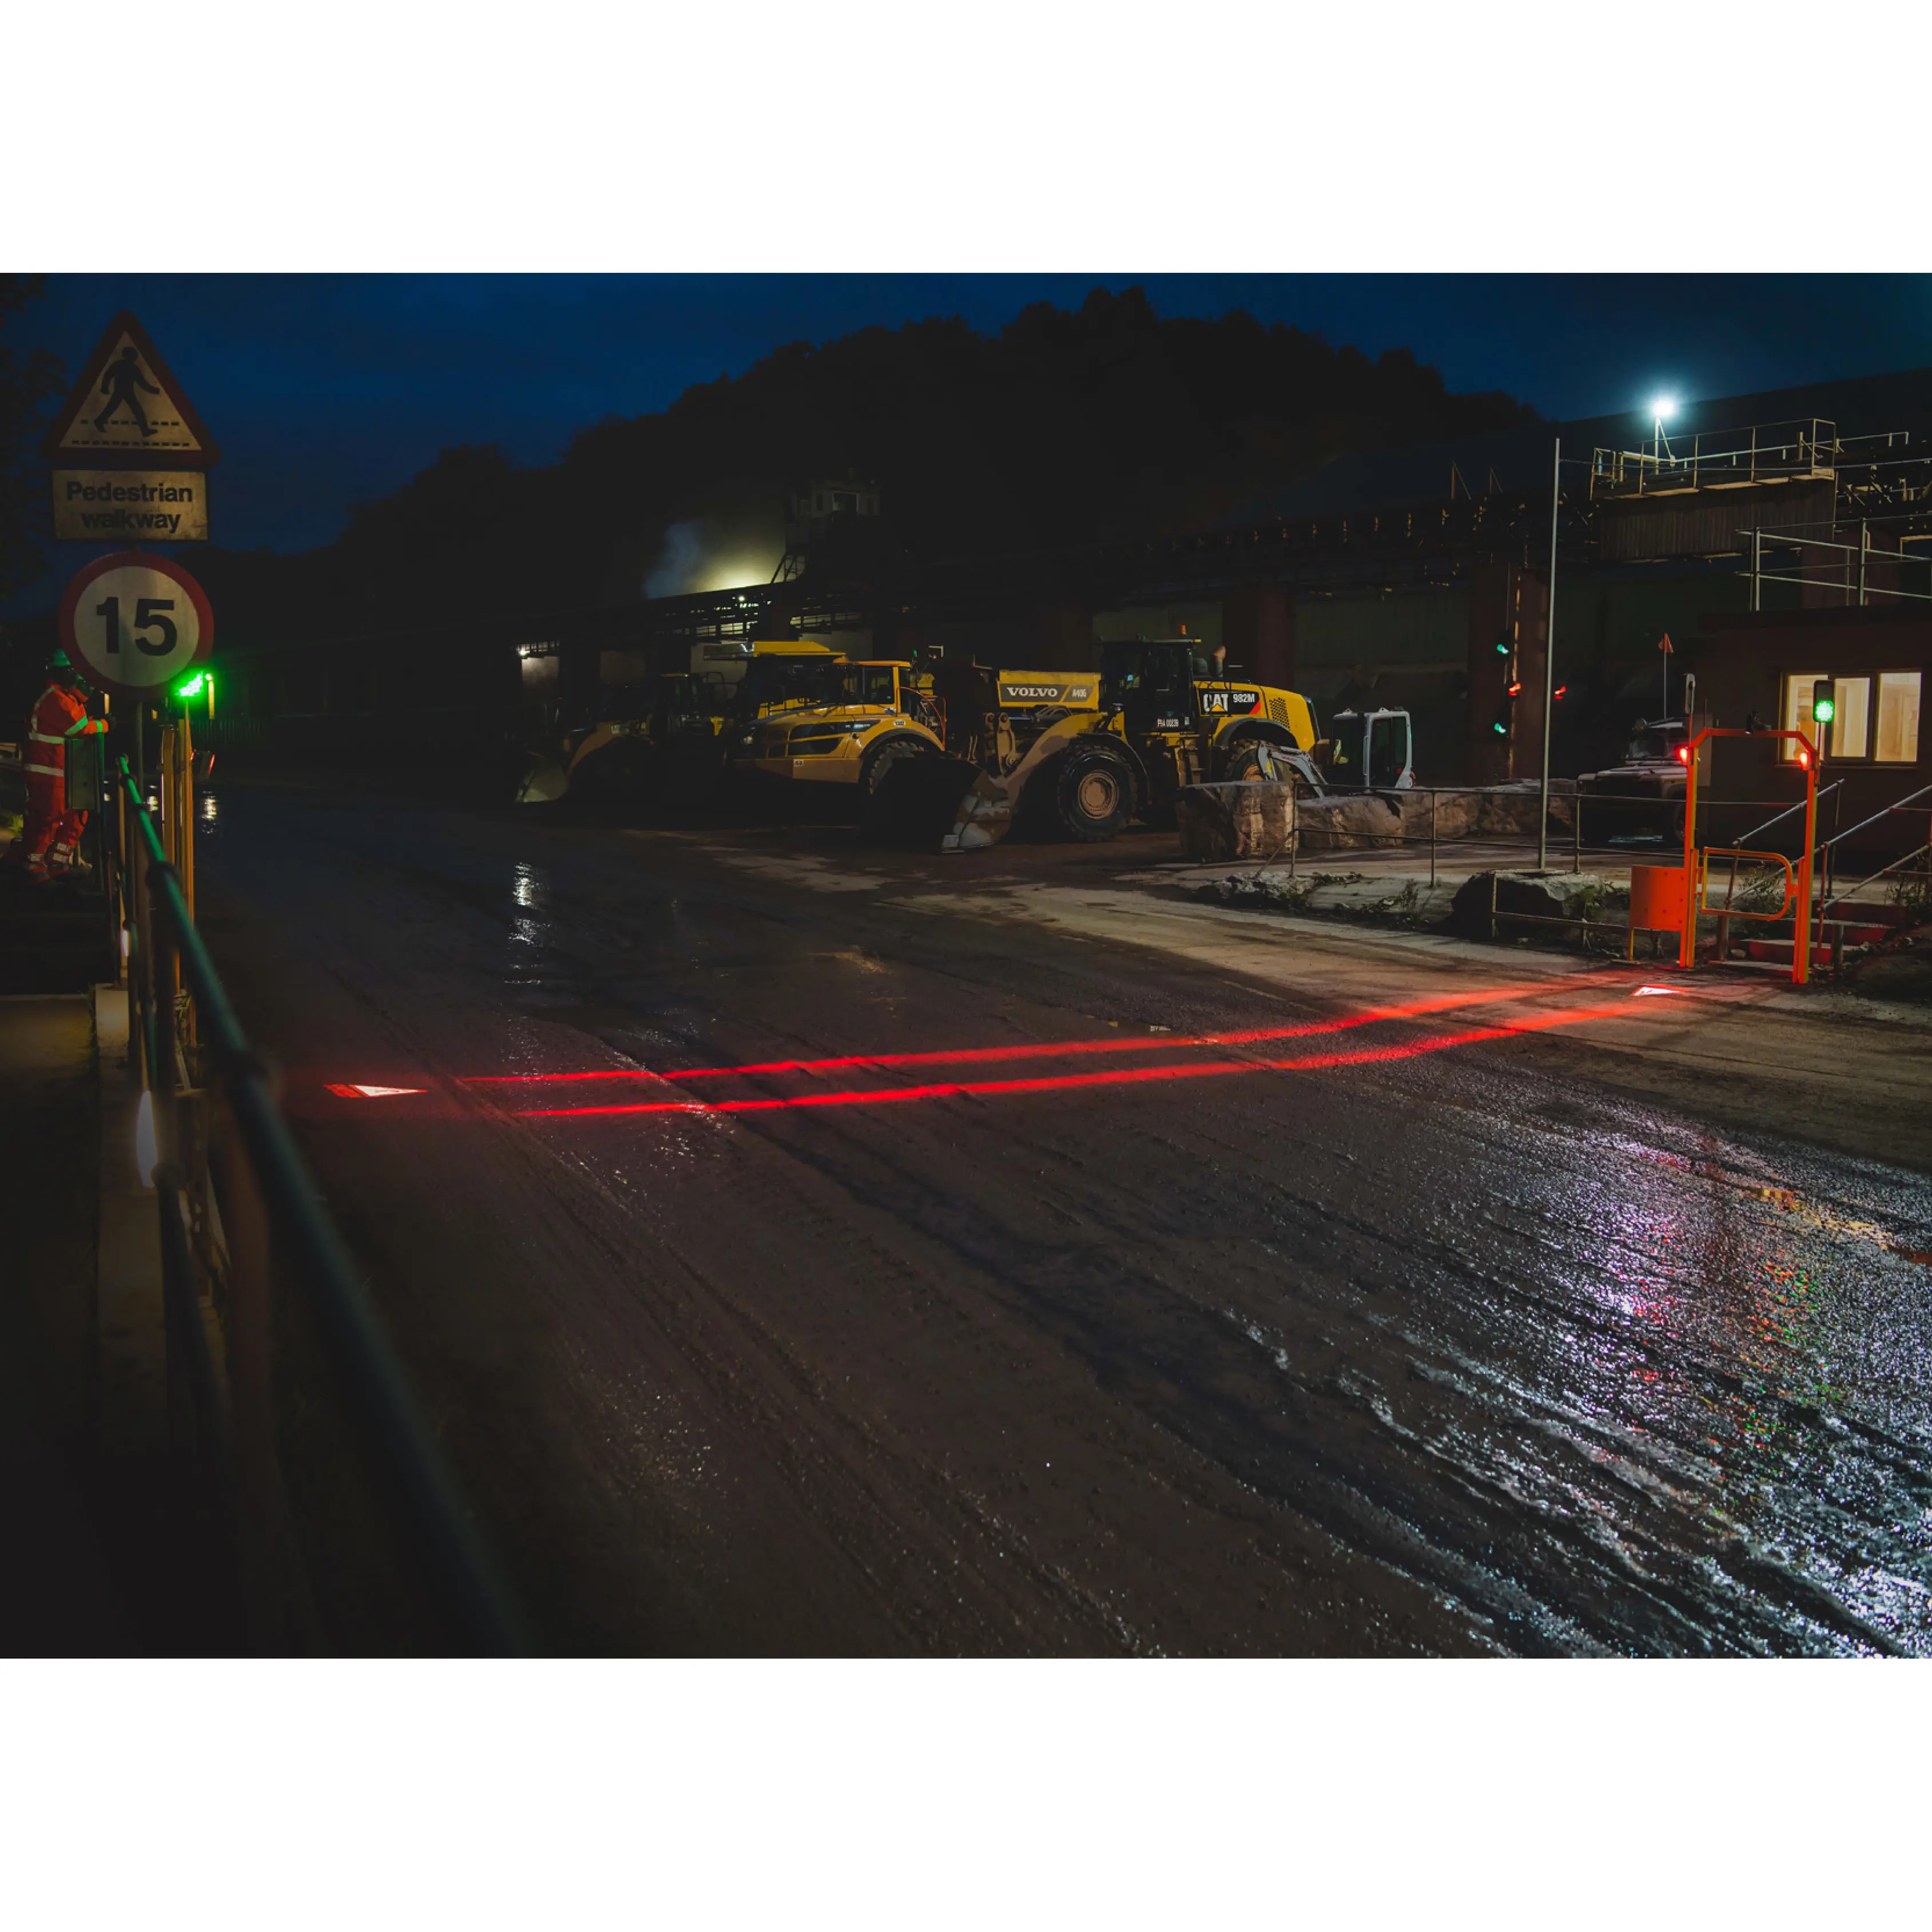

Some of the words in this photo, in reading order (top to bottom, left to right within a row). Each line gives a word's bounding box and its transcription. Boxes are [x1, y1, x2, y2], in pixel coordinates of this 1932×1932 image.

[67, 481, 193, 503] Pedestrian
[82, 510, 181, 534] walkway
[96, 596, 178, 656] 15
[1007, 687, 1058, 697] VOLVO
[1203, 693, 1229, 712] CAT
